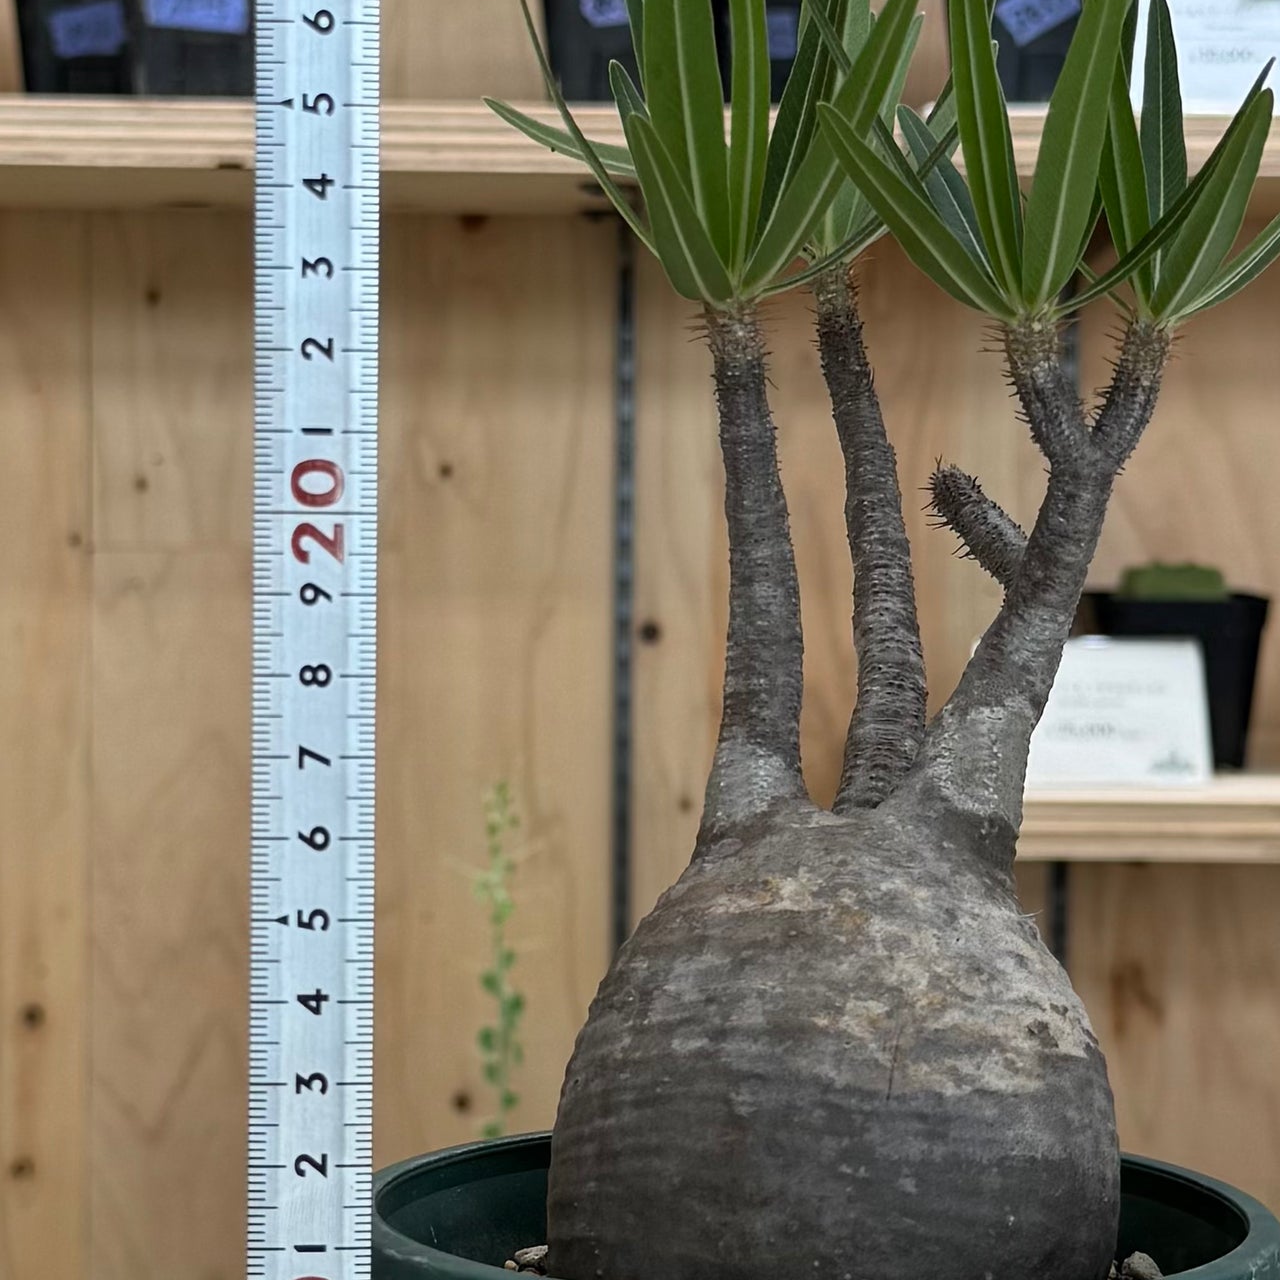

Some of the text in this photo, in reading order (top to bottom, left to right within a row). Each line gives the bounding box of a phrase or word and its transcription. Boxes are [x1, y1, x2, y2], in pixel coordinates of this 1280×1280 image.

[302, 10, 335, 34] 6
[302, 93, 334, 115] 5
[302, 173, 334, 200] 4
[302, 257, 333, 278] 3
[301, 338, 333, 361] 2
[301, 427, 333, 436] 1
[290, 458, 342, 564] 20
[300, 583, 332, 606] 9
[299, 664, 332, 688] 8
[298, 745, 331, 770] 7
[298, 826, 330, 851] 6
[297, 909, 329, 931] 5
[297, 989, 329, 1015] 4
[296, 1073, 328, 1095] 3
[295, 1154, 327, 1177] 2
[294, 1244, 326, 1253] 1
